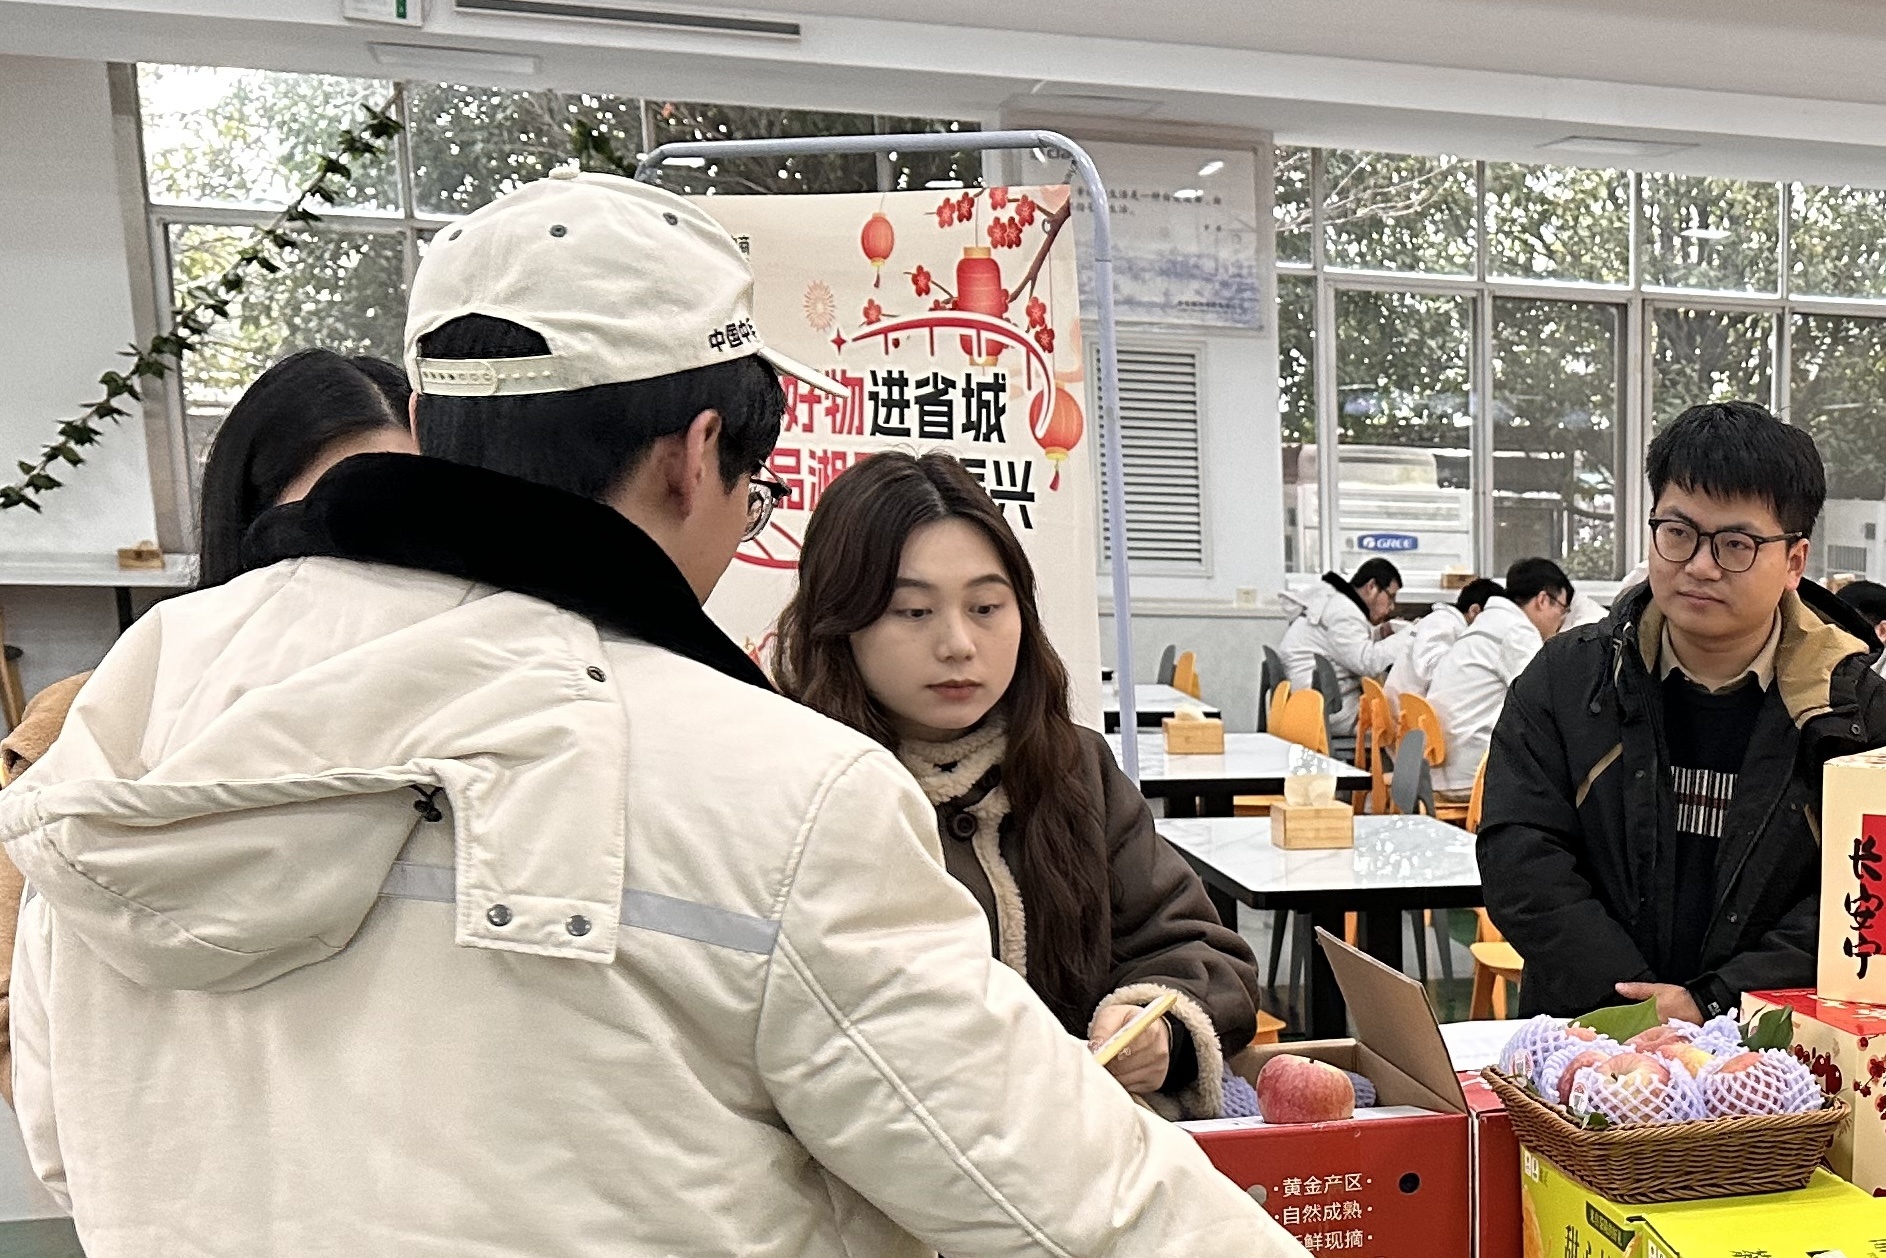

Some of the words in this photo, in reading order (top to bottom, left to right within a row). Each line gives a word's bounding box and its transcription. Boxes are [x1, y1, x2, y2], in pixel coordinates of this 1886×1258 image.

[1282, 1173, 1363, 1198] 黄金产区
[1282, 1200, 1363, 1226] 自然成熟
